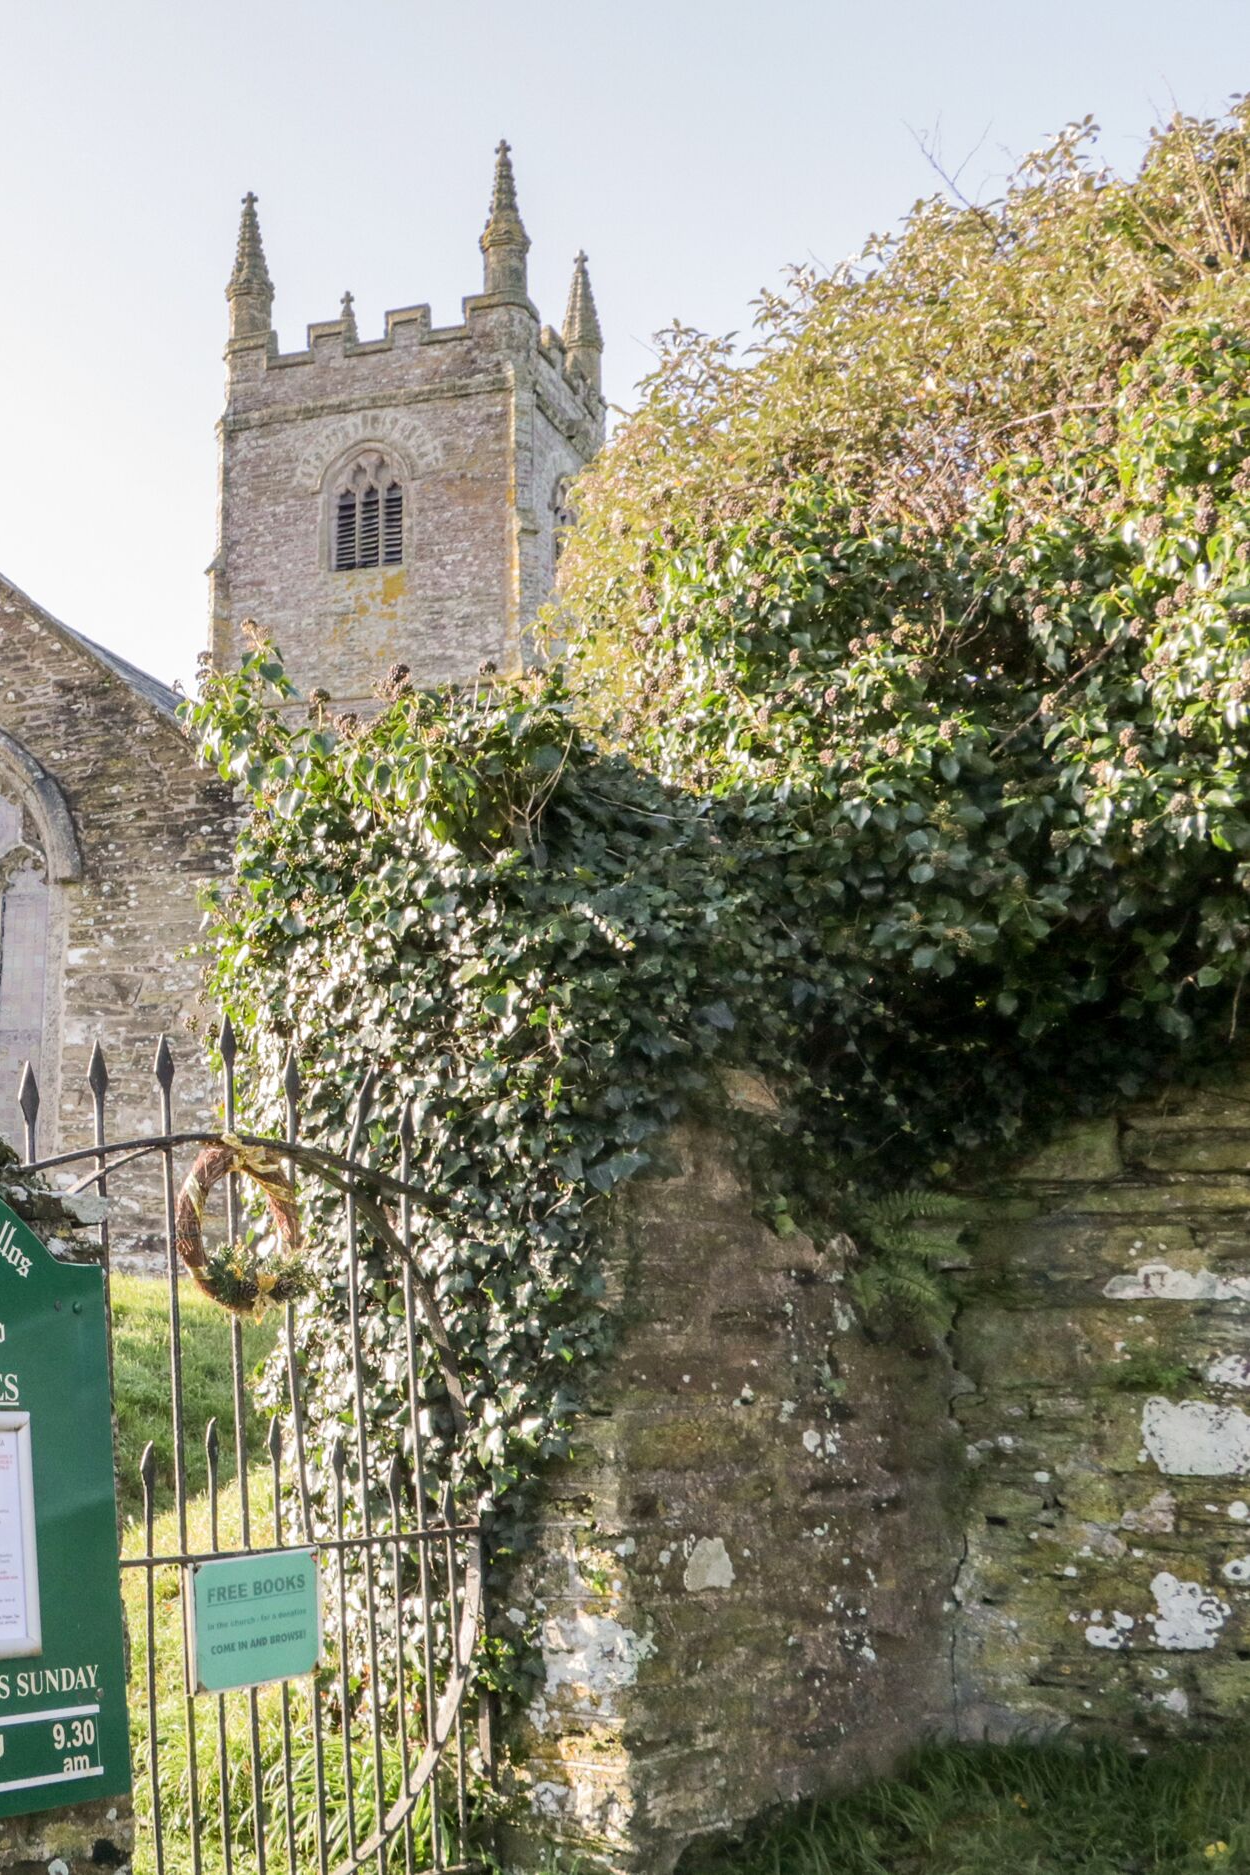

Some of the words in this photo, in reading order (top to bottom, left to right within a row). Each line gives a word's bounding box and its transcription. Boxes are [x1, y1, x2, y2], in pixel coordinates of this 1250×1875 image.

[207, 1583, 248, 1603] FREE
[253, 1574, 306, 1596] BOOKS
[210, 1642, 236, 1655] COME
[238, 1640, 248, 1650] IN
[250, 1637, 268, 1648] AND
[16, 1664, 99, 1697] SUNDAY
[52, 1719, 95, 1750] 9.30
[63, 1753, 90, 1774] am
